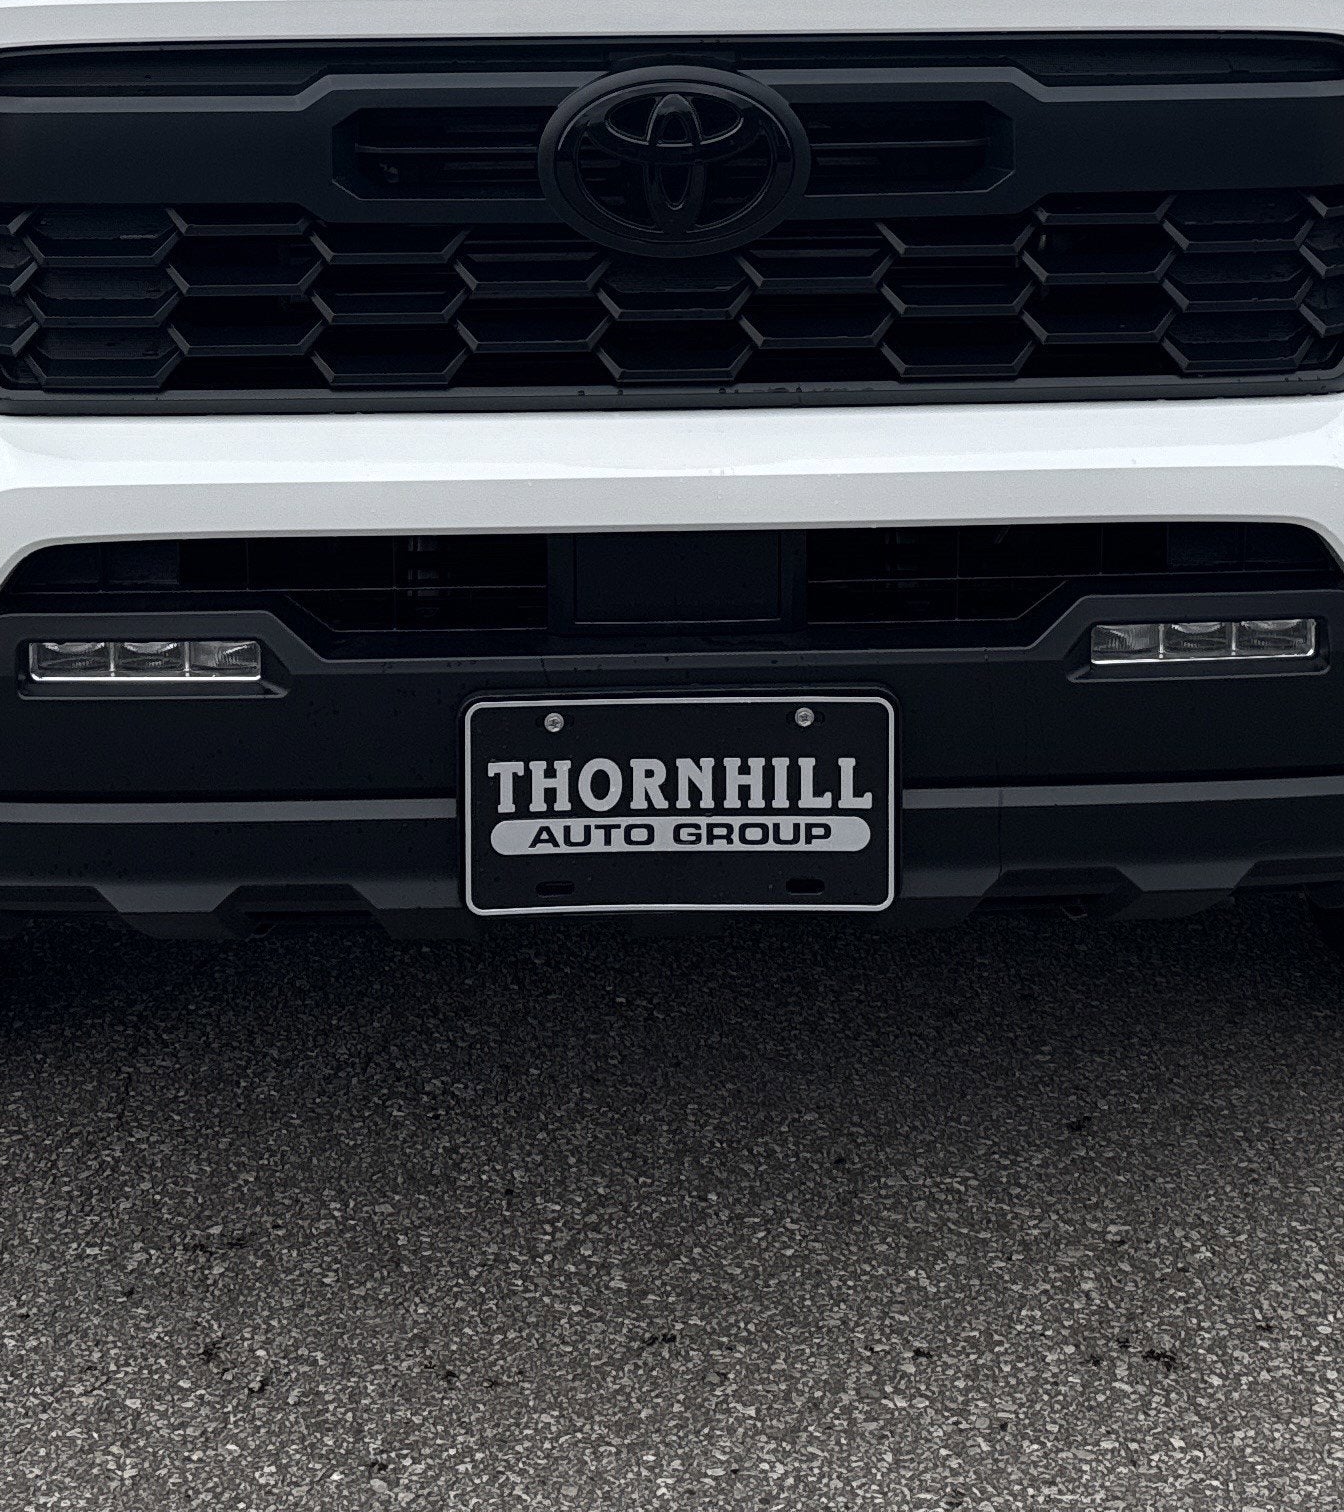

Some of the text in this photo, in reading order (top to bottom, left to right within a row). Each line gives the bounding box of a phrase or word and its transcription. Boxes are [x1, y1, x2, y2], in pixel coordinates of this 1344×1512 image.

[487, 757, 873, 813] THORNHILL
[528, 821, 832, 849] AUTO GROUP
